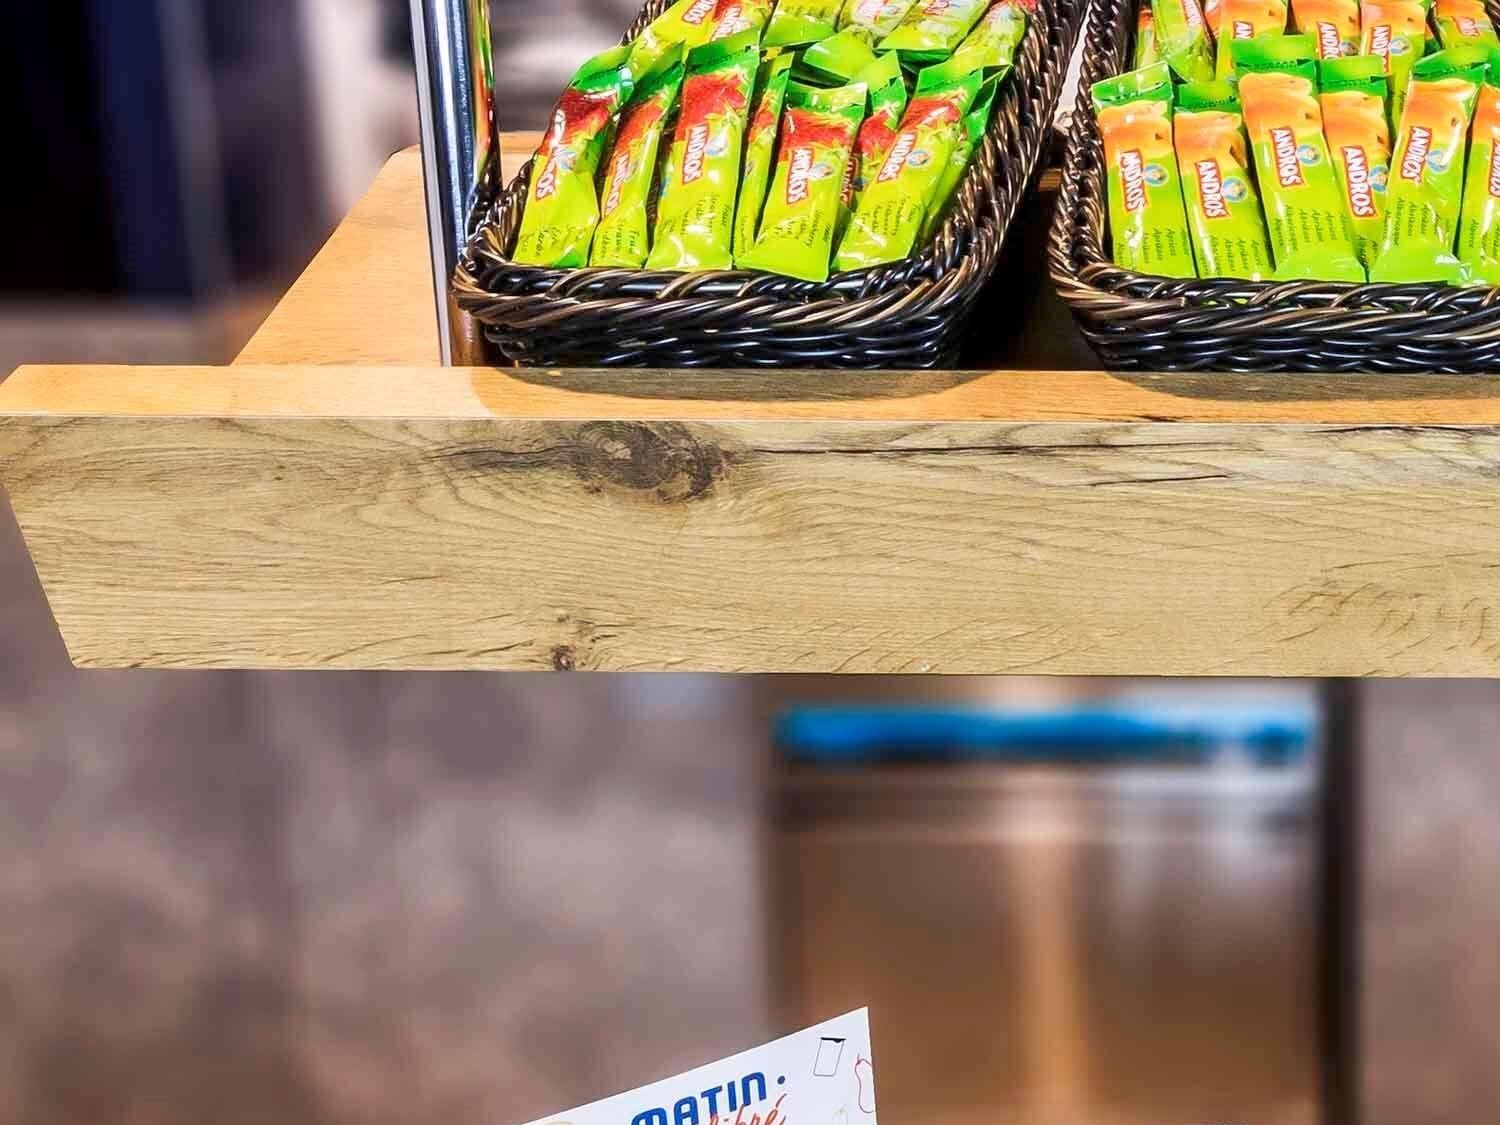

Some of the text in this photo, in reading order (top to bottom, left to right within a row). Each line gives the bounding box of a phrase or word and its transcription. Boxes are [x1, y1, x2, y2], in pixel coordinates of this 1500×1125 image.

[1121, 152, 1143, 210] ANDROS
[1273, 129, 1300, 185] ANDROS
[1345, 148, 1373, 216] ANDROS
[1402, 128, 1430, 183] ANDROS
[1198, 162, 1226, 217] ANDROS
